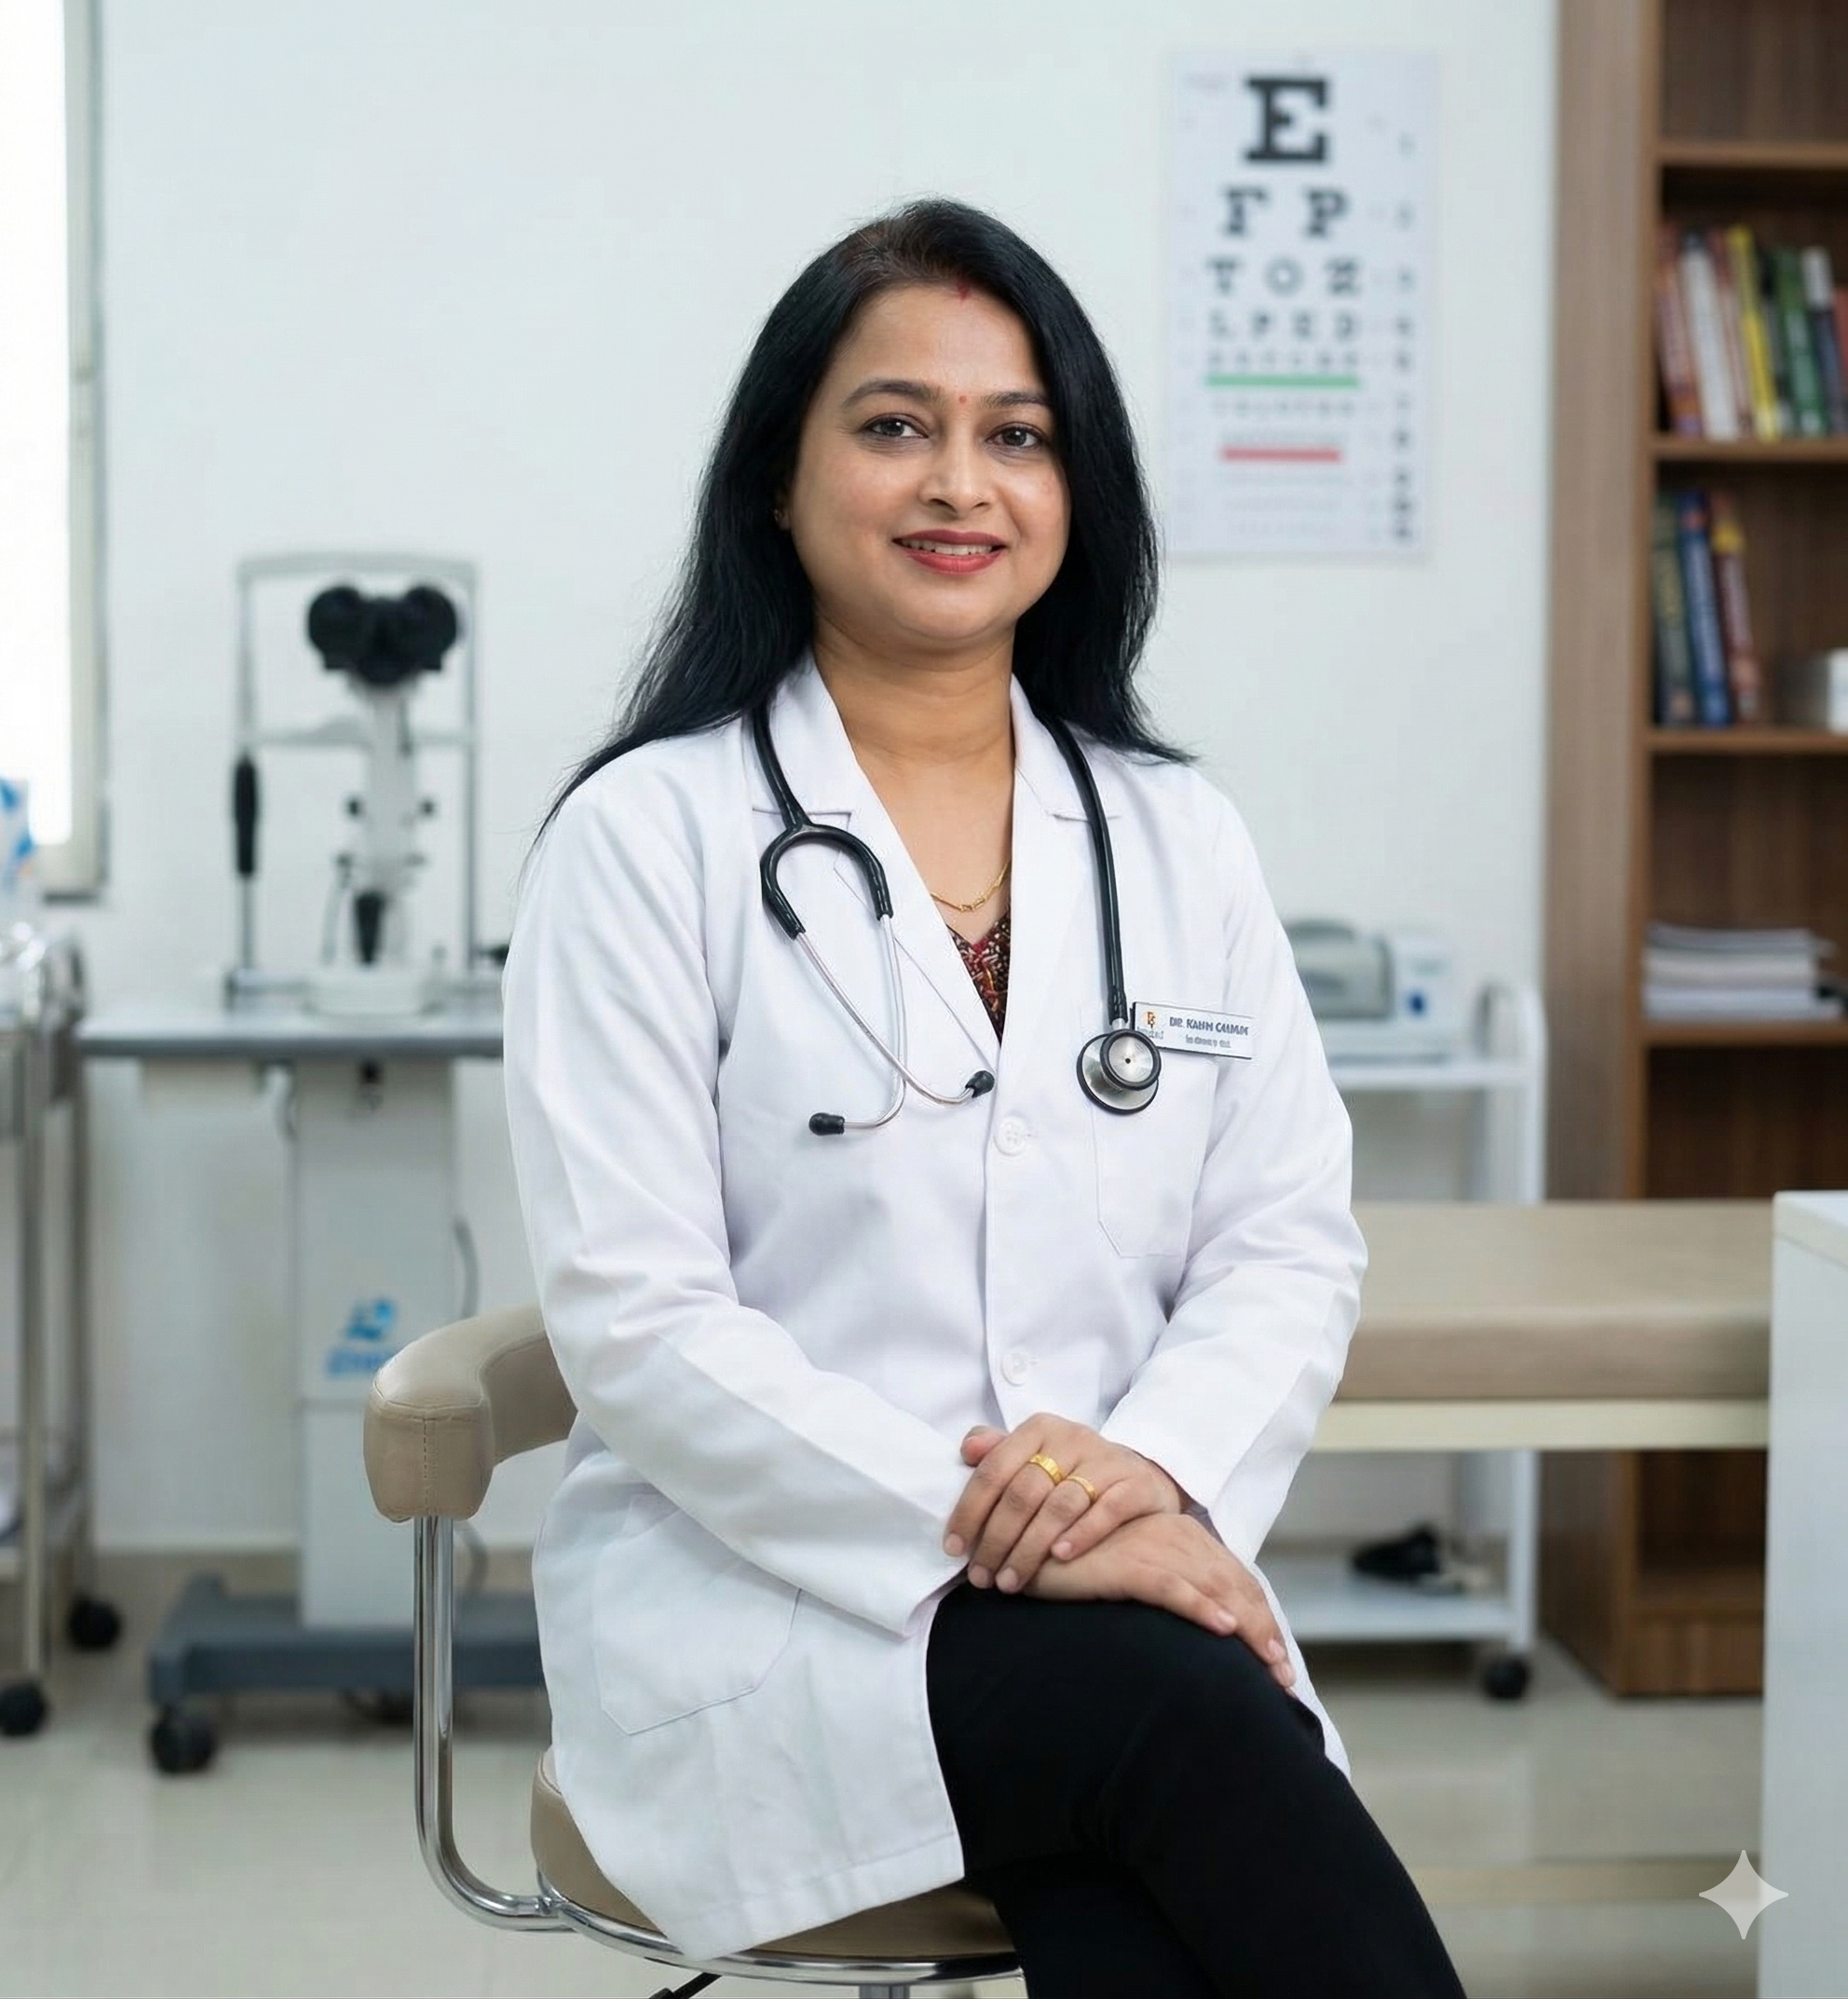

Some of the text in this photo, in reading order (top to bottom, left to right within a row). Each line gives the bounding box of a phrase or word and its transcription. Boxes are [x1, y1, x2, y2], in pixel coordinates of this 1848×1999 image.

[1243, 75, 1327, 164] E
[1304, 184, 1352, 237] P
[1205, 255, 1242, 296] T
[1263, 257, 1304, 298] O
